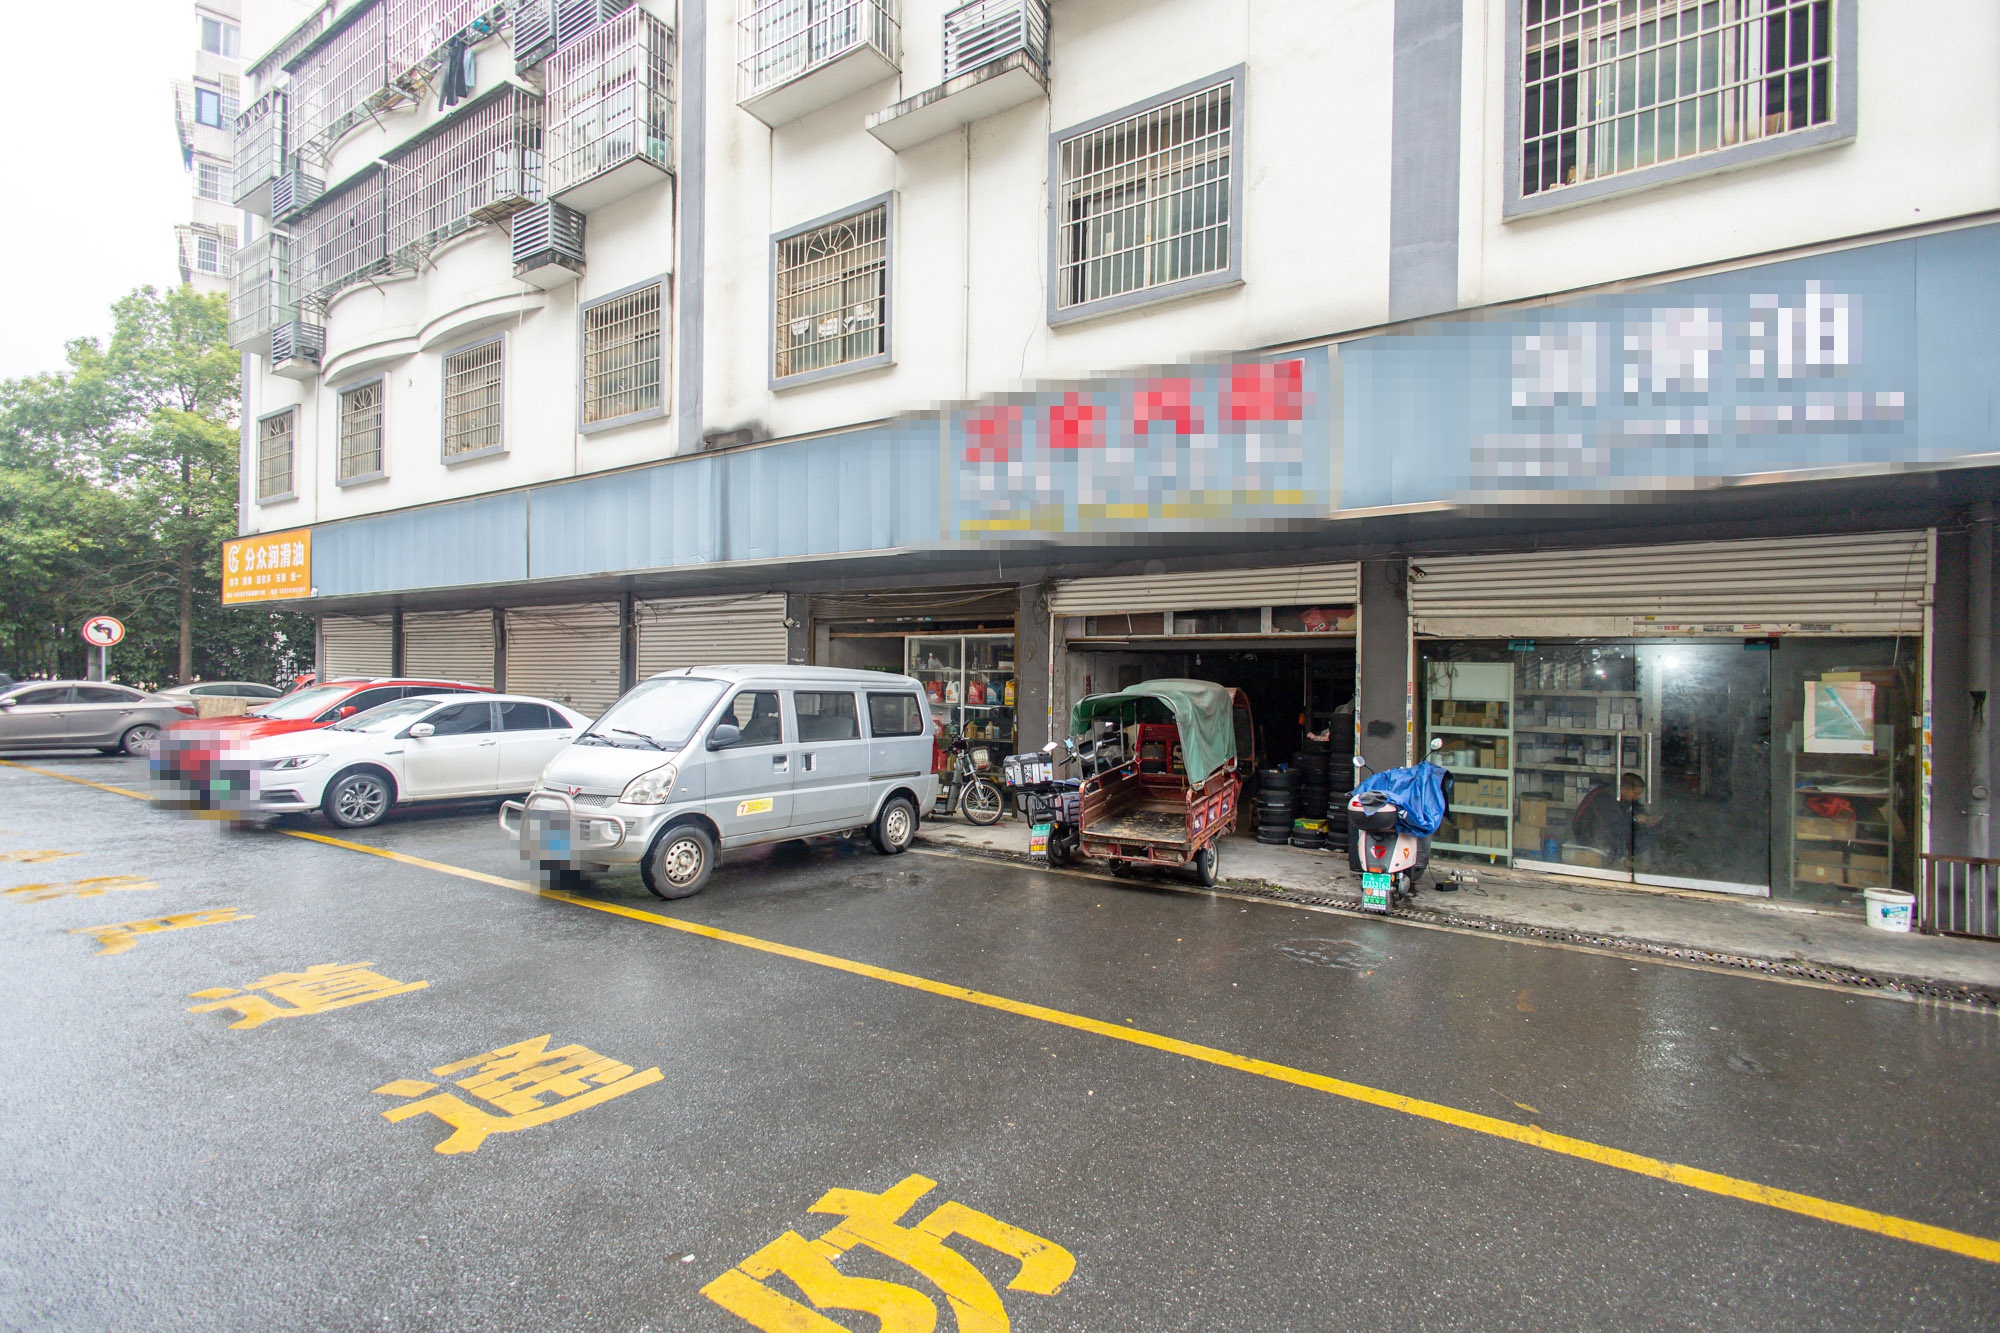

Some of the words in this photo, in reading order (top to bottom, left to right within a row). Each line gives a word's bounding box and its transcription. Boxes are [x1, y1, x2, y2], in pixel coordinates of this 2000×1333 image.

[245, 541, 304, 571] 分众润滑油
